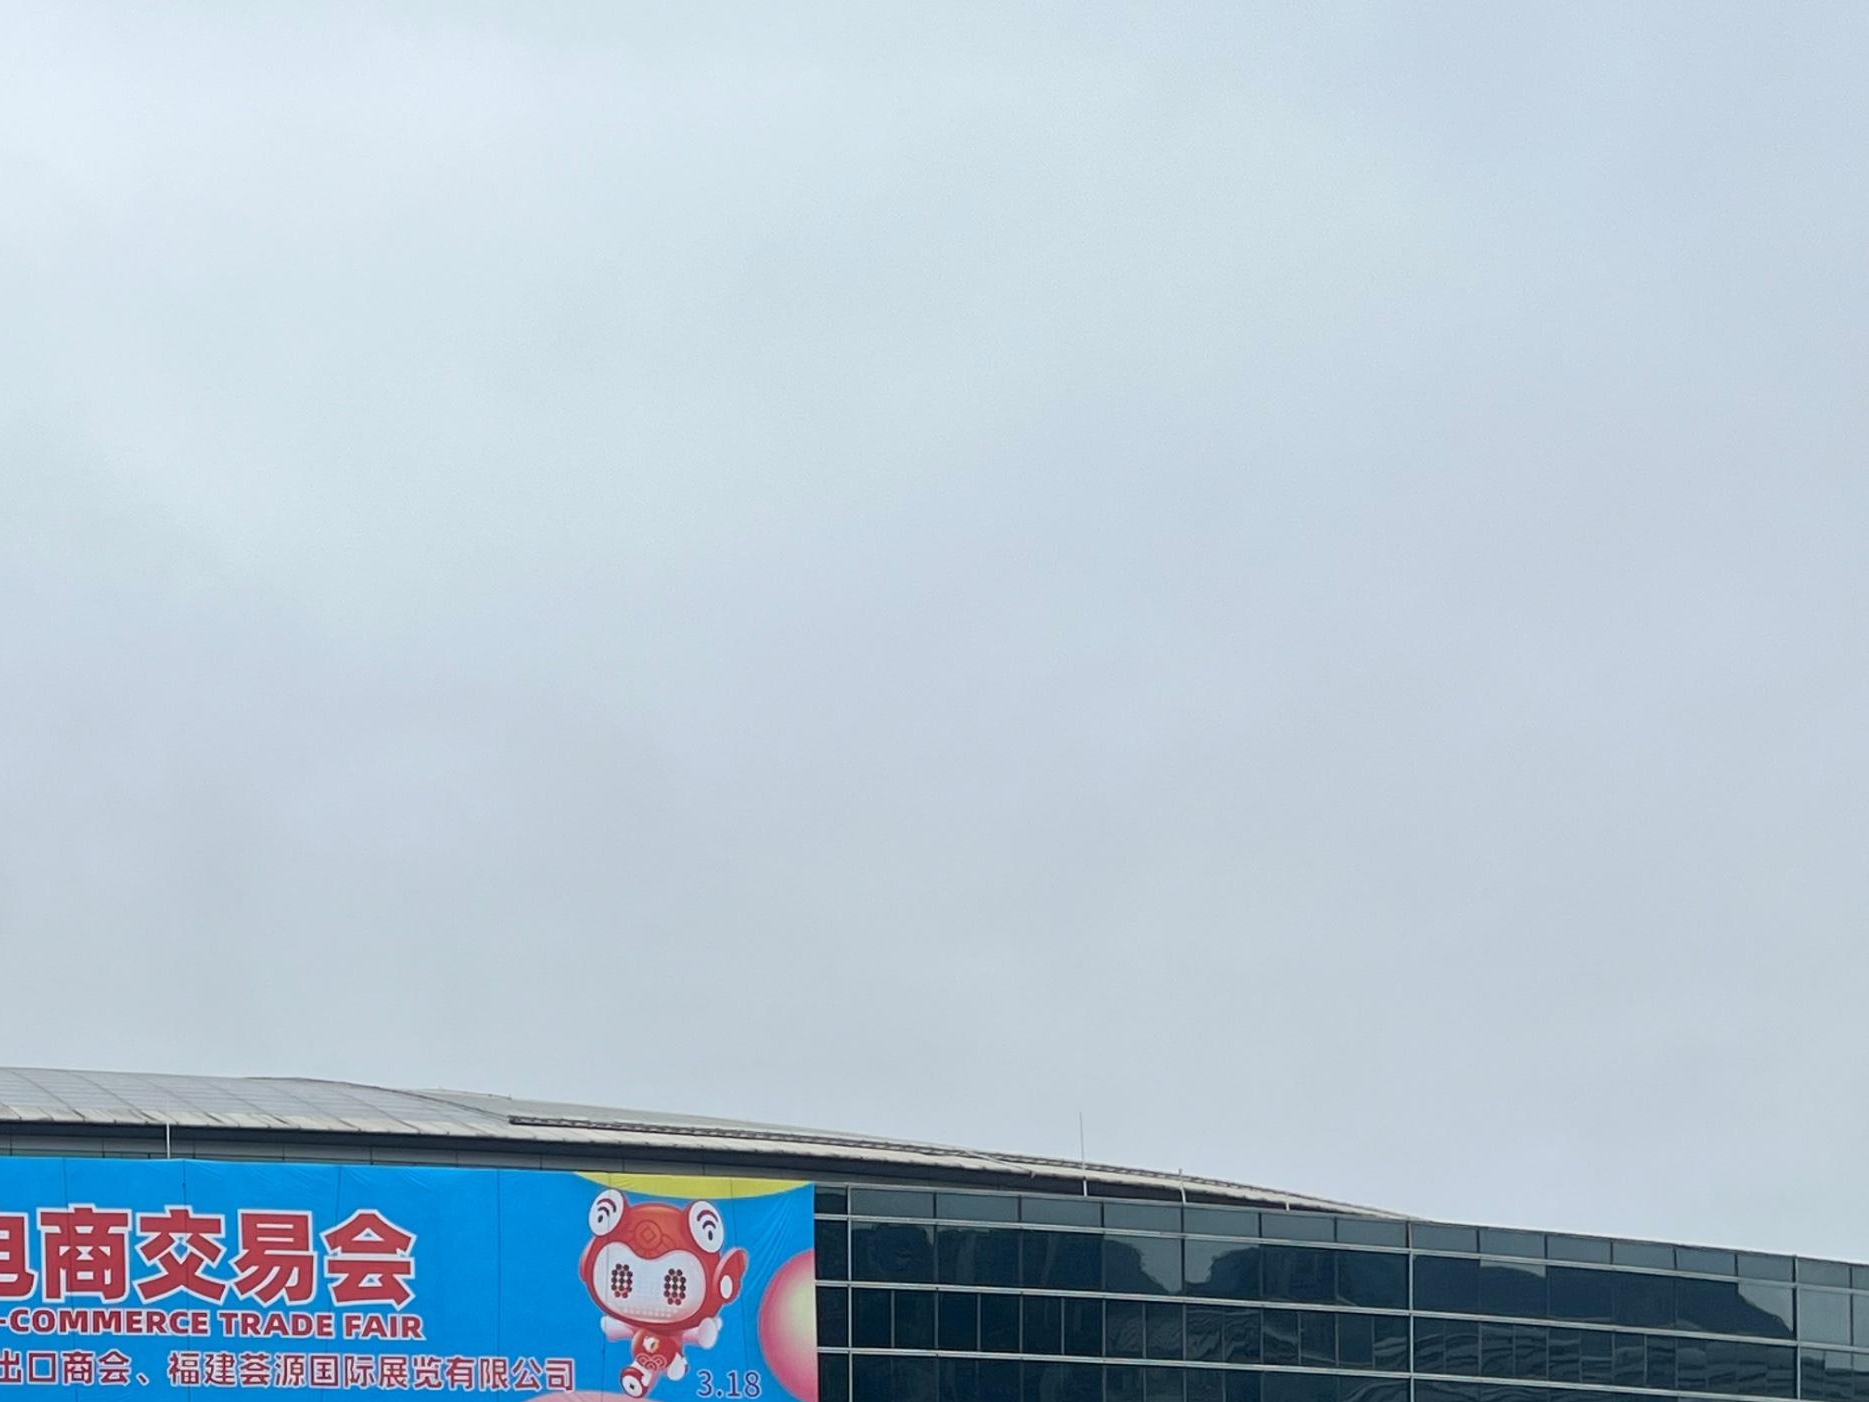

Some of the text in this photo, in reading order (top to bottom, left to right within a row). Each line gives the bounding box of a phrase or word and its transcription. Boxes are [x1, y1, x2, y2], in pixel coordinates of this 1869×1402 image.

[220, 1309, 339, 1339] TRADE
[342, 1311, 427, 1341] FAIR
[696, 1368, 762, 1400] 3.18
